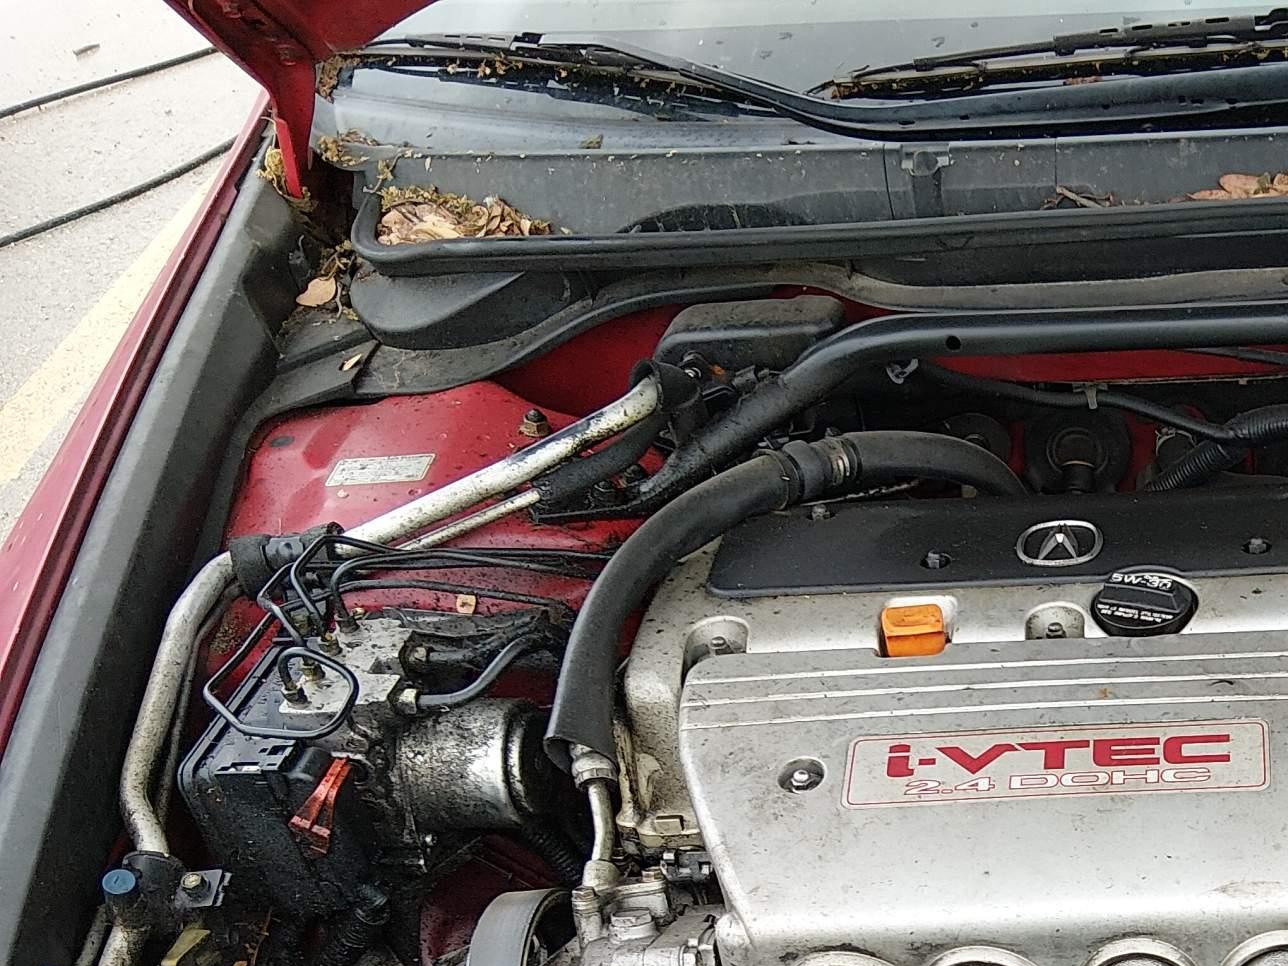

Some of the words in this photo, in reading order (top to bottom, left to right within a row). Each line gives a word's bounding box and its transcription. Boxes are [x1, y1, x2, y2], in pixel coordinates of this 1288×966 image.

[1111, 572, 1173, 591] 5W-30
[885, 733, 1232, 779] i-VTEC
[903, 776, 996, 797] 2.4
[1008, 767, 1212, 791] DOHC
